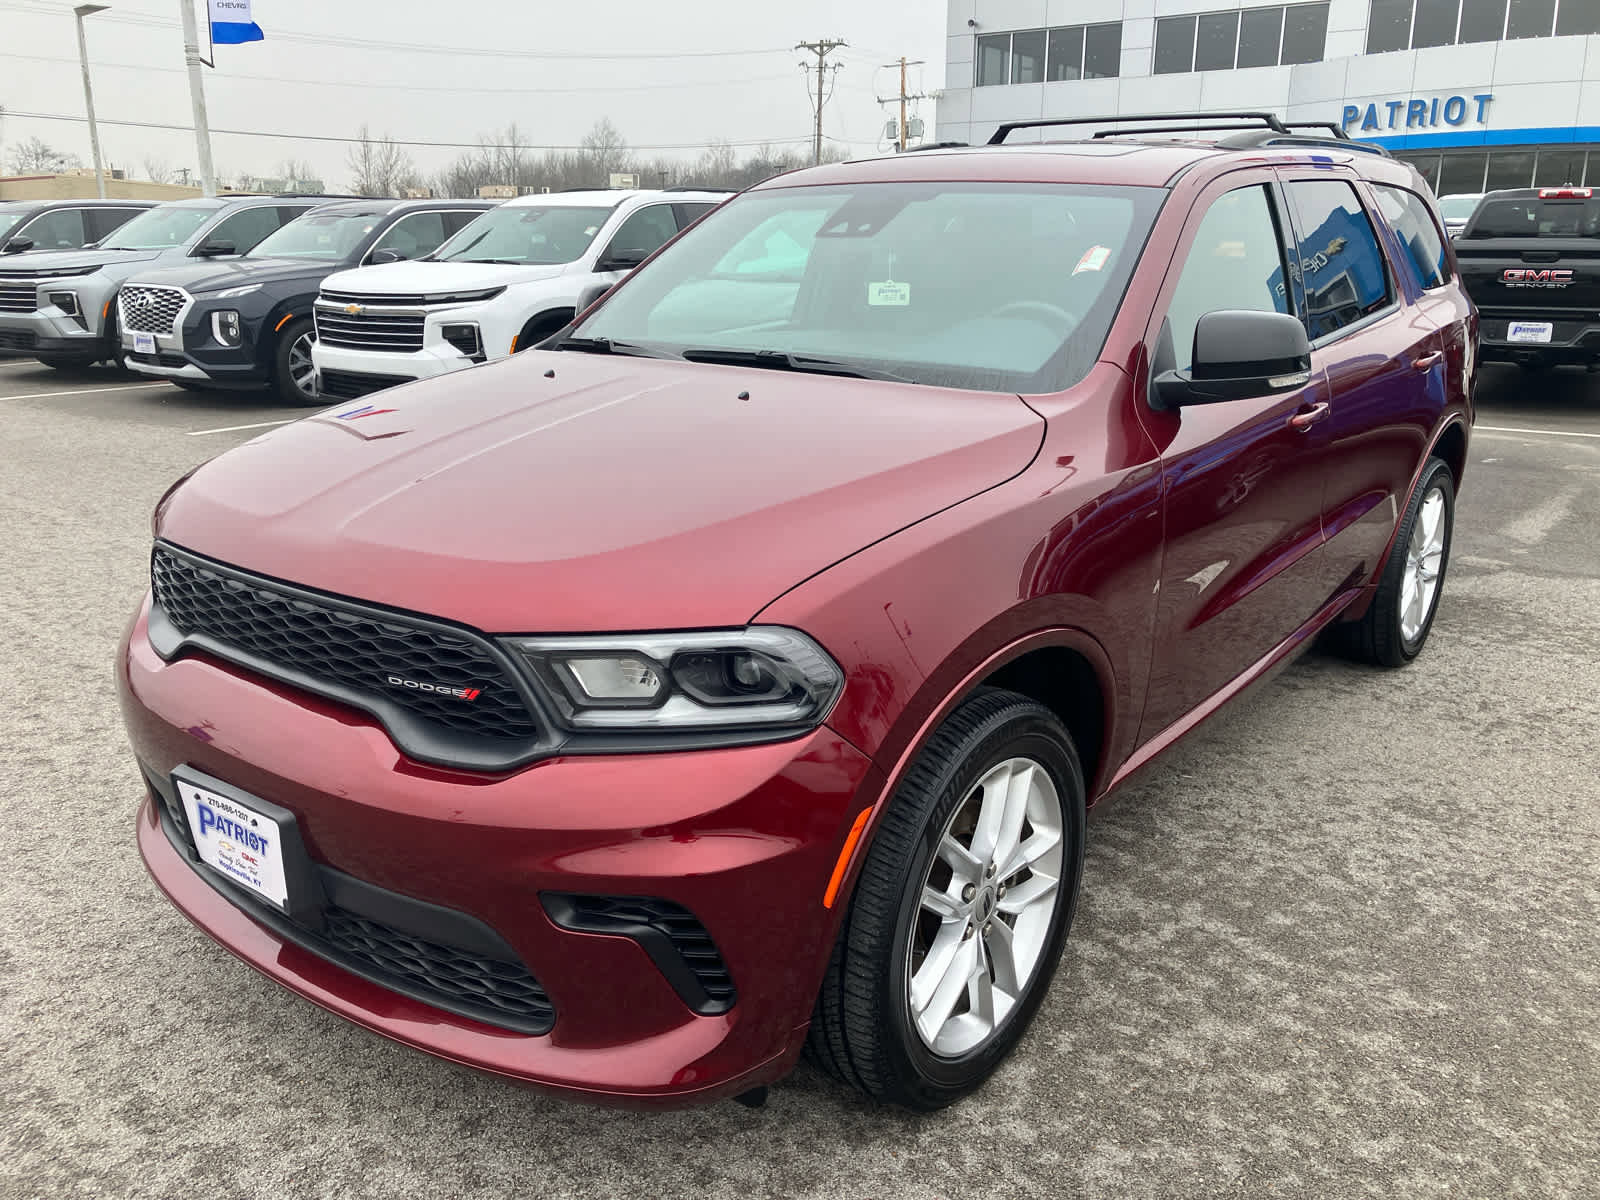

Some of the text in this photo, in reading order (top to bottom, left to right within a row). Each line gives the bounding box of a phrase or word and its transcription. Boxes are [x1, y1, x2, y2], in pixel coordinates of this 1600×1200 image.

[1341, 94, 1493, 131] PATRIOT
[1503, 269, 1573, 282] GMC
[388, 676, 469, 698] DODGE
[197, 803, 269, 856] PATRIOT
